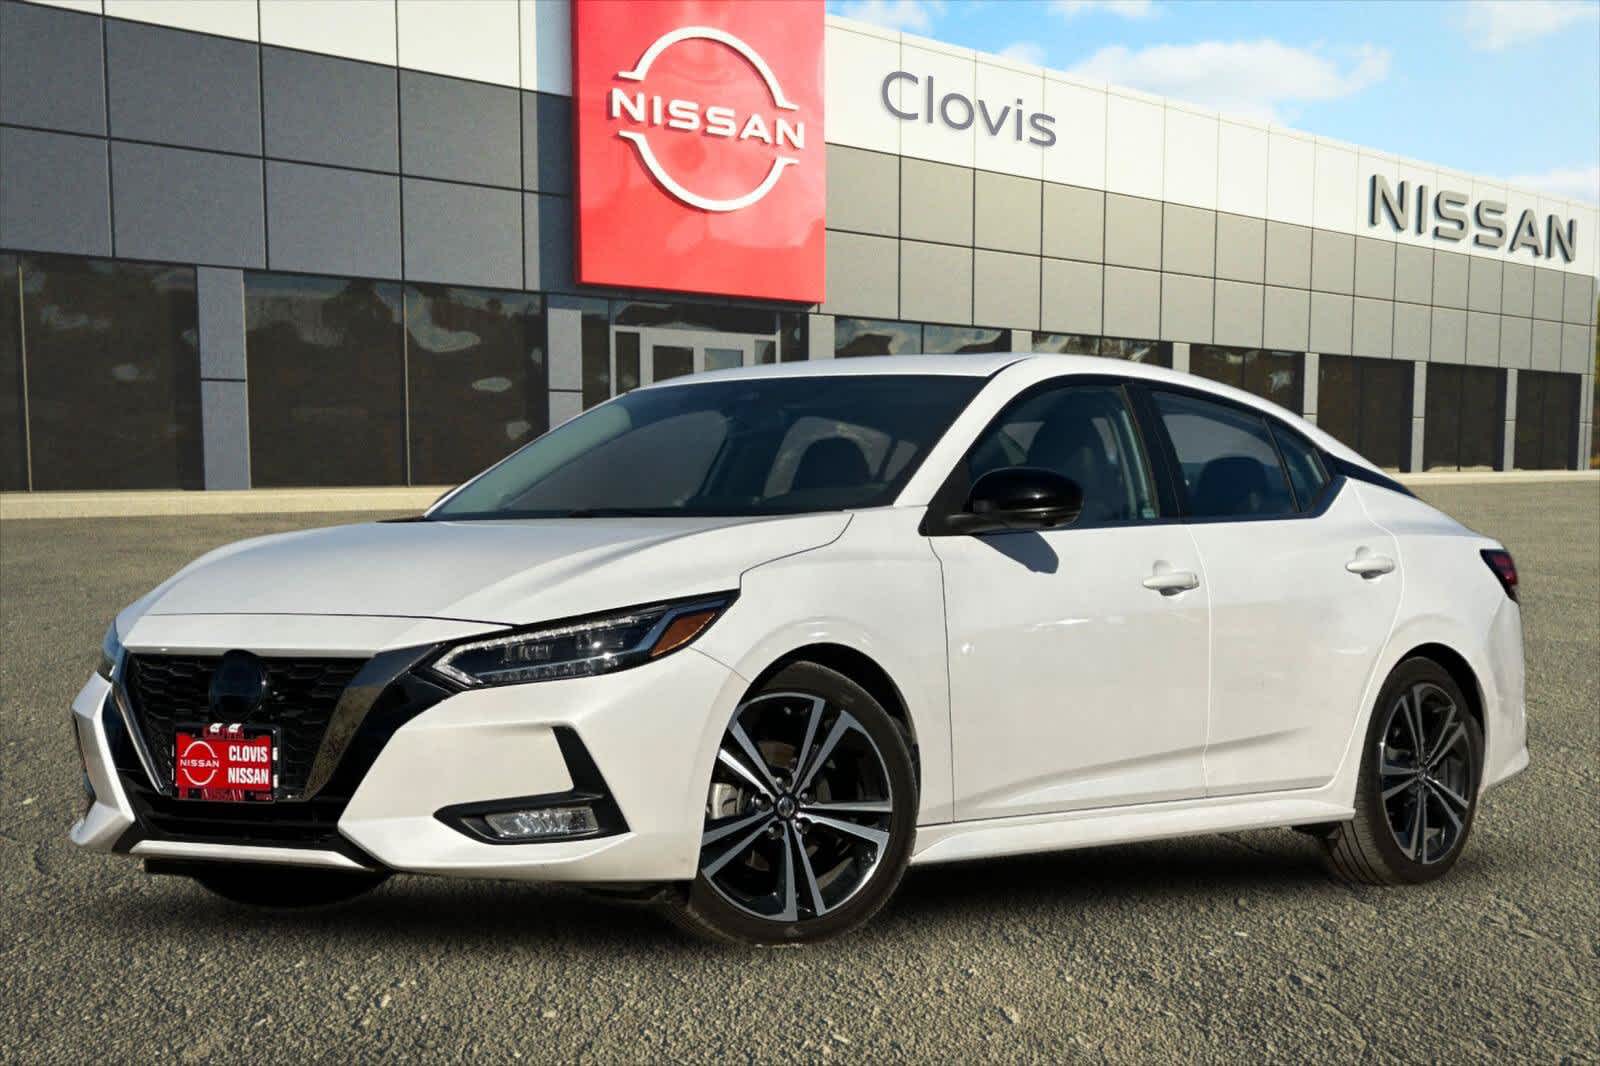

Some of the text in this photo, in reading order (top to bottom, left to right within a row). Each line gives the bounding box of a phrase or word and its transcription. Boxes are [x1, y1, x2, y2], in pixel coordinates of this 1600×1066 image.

[609, 88, 805, 149] NISSAN
[882, 71, 1057, 147] Clovis
[1369, 174, 1577, 262] NISSAN
[180, 759, 219, 768] NISSAN
[228, 745, 268, 762] CLOVIS
[227, 767, 269, 784] NISSAN
